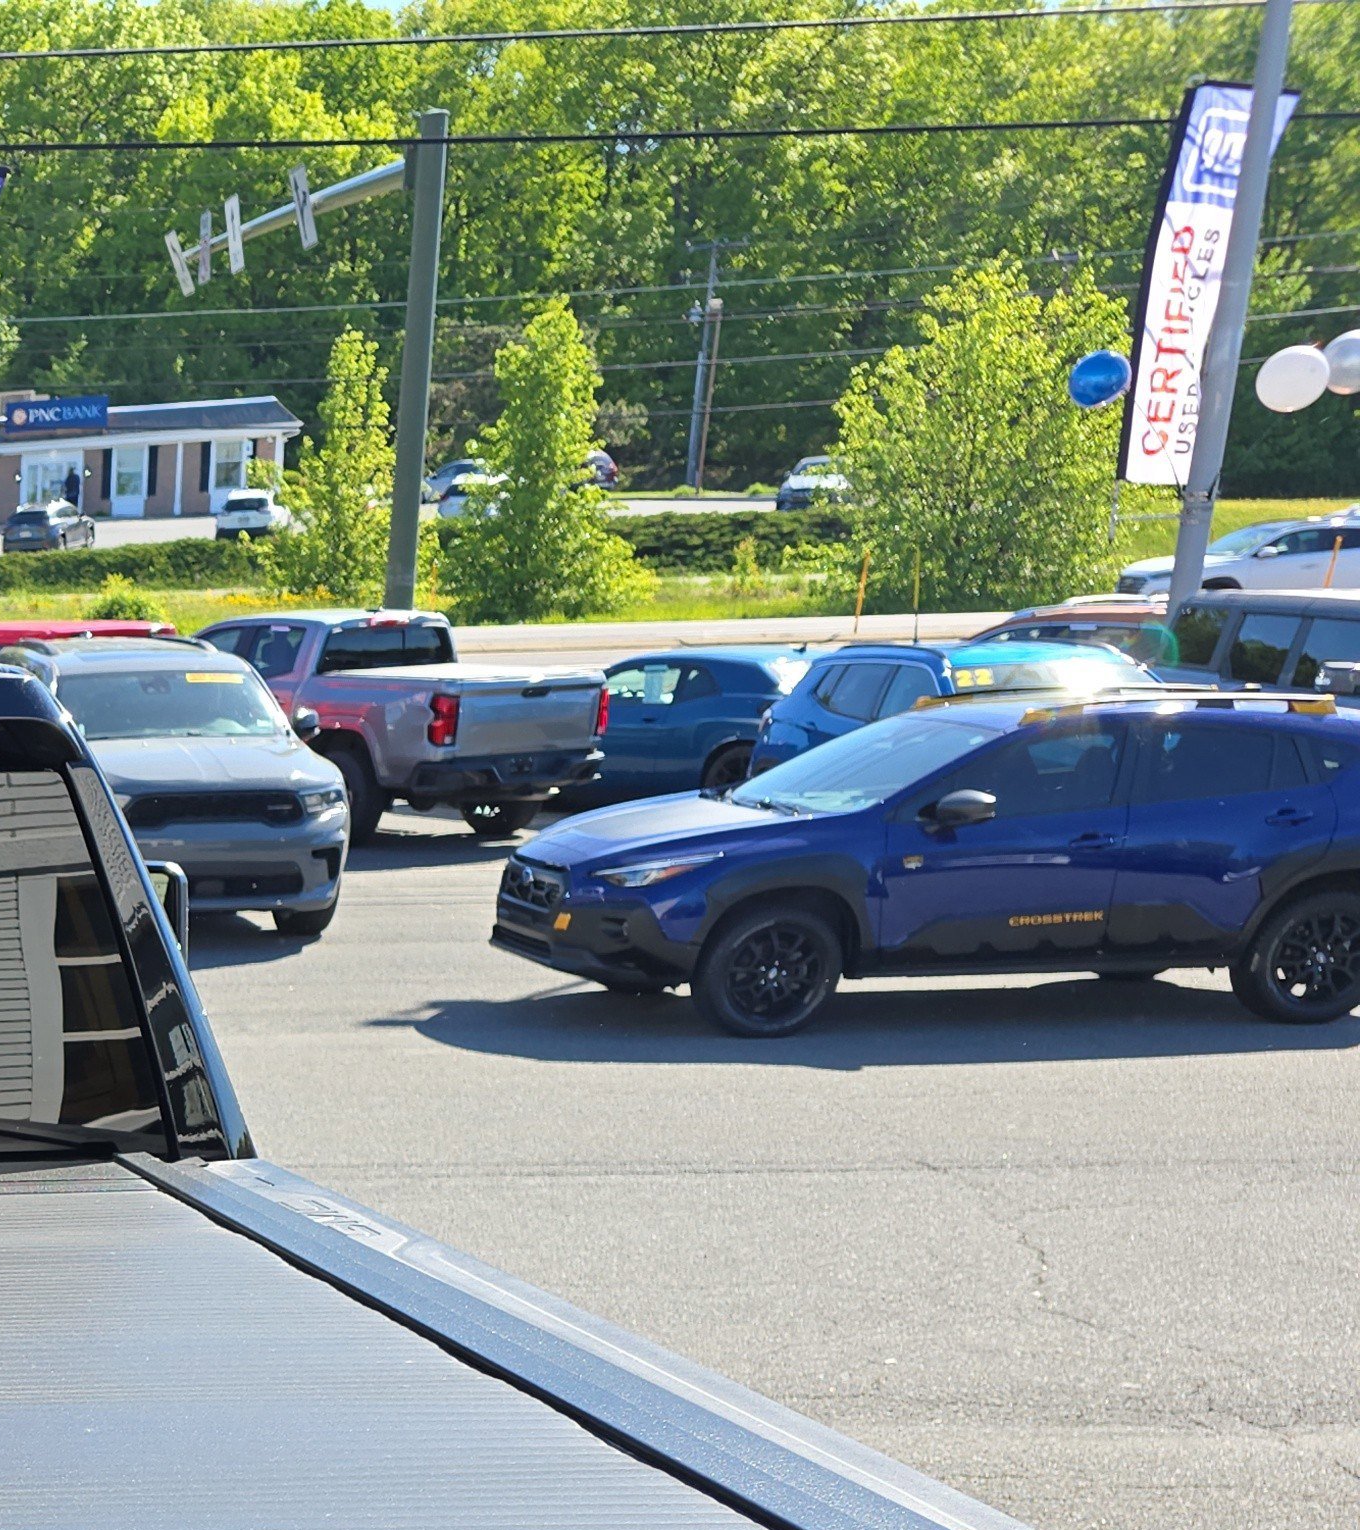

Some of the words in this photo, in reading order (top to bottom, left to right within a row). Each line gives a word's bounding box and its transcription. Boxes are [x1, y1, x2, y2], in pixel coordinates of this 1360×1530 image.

[1141, 225, 1195, 457] CERTIFIED
[1174, 383, 1200, 455] USED
[955, 668, 994, 688] 22
[1008, 910, 1104, 927] CROSSTREK
